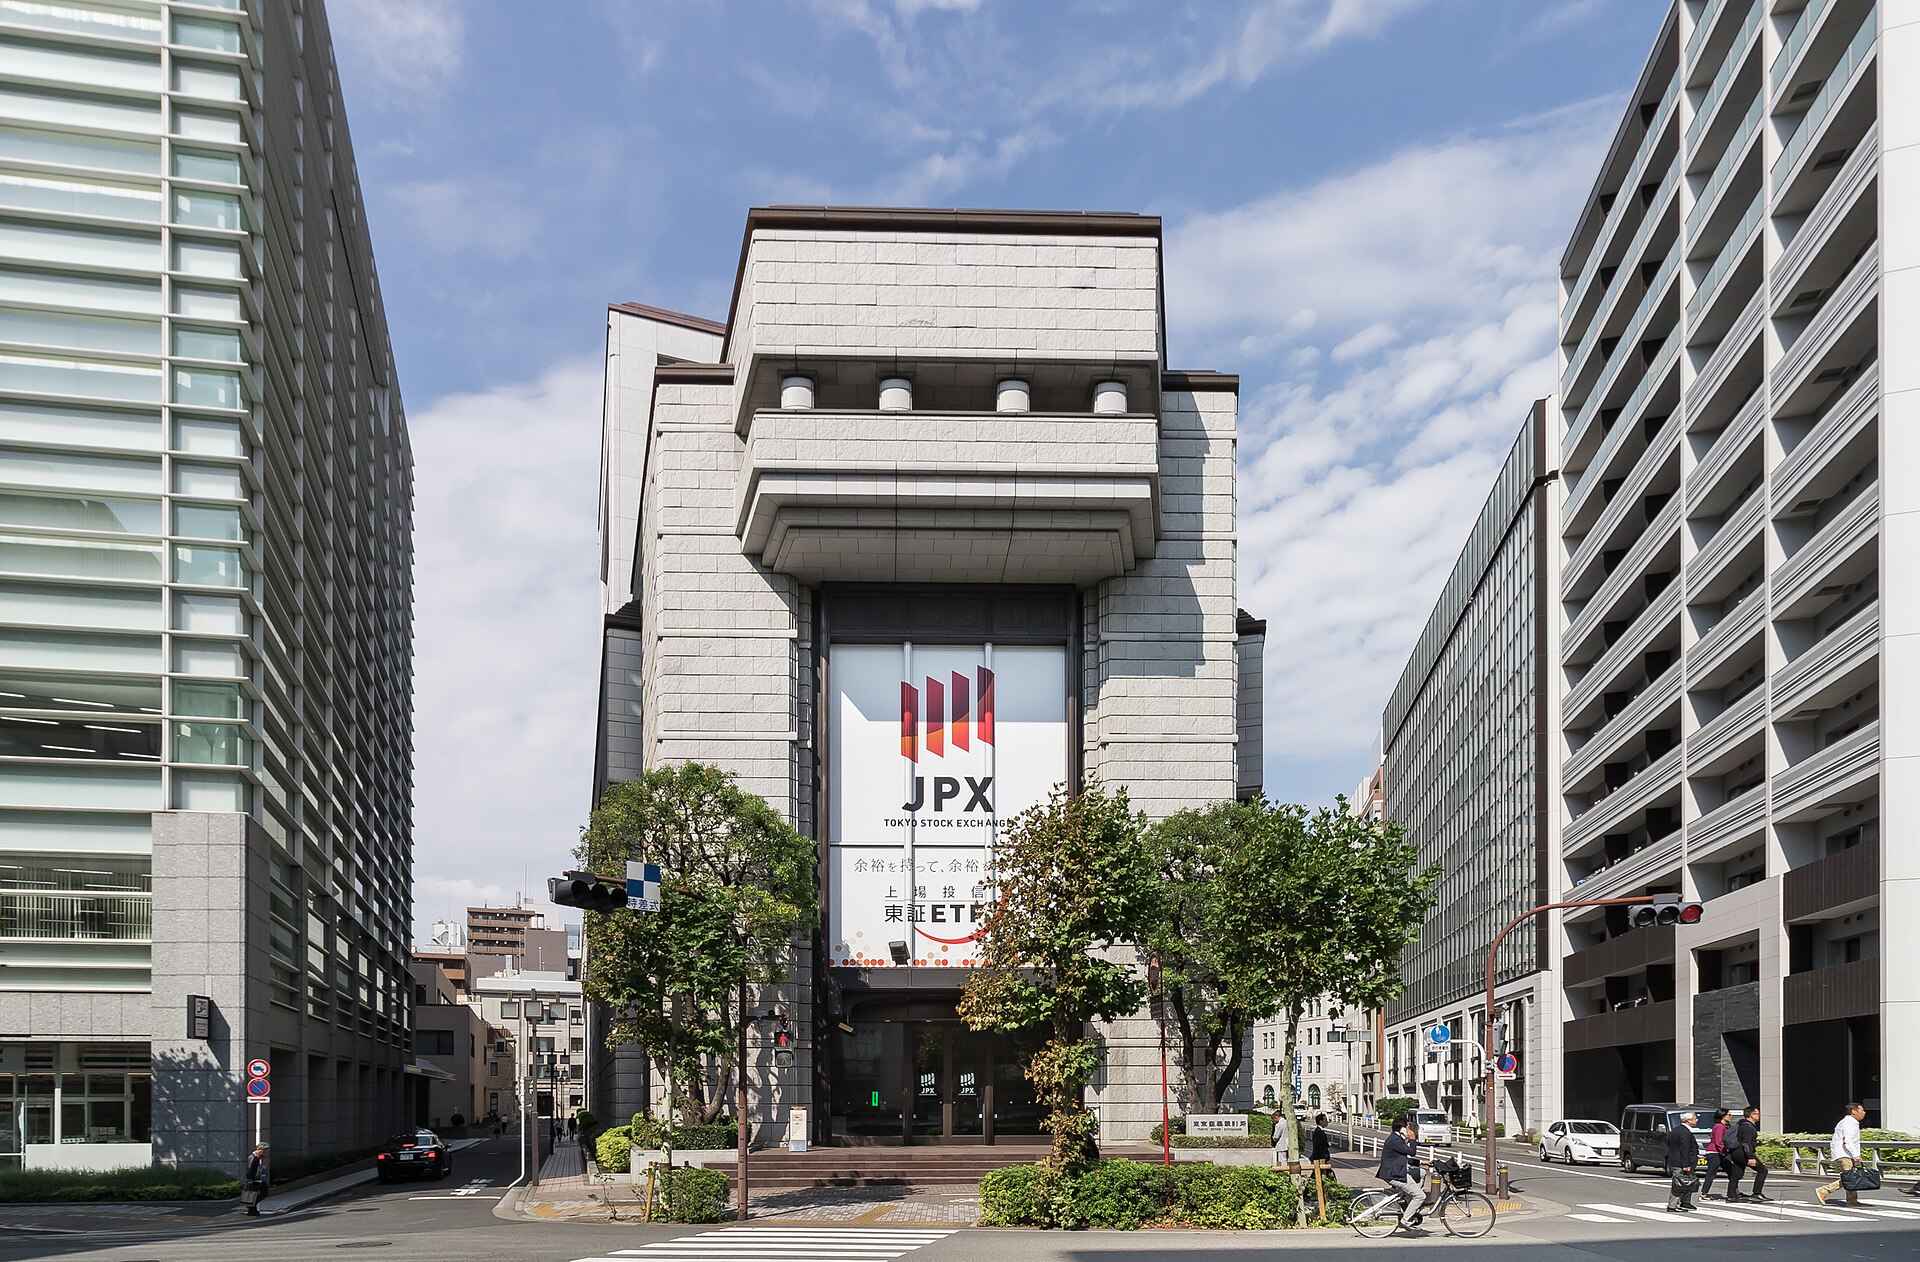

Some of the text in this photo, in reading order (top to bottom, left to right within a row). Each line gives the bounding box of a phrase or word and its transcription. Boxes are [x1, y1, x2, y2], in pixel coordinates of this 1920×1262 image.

[901, 776, 995, 813] JPX
[884, 818, 918, 828] TOKYO
[920, 818, 954, 828] STOCK
[884, 885, 985, 899] 上場投信
[628, 898, 658, 910] 時差式
